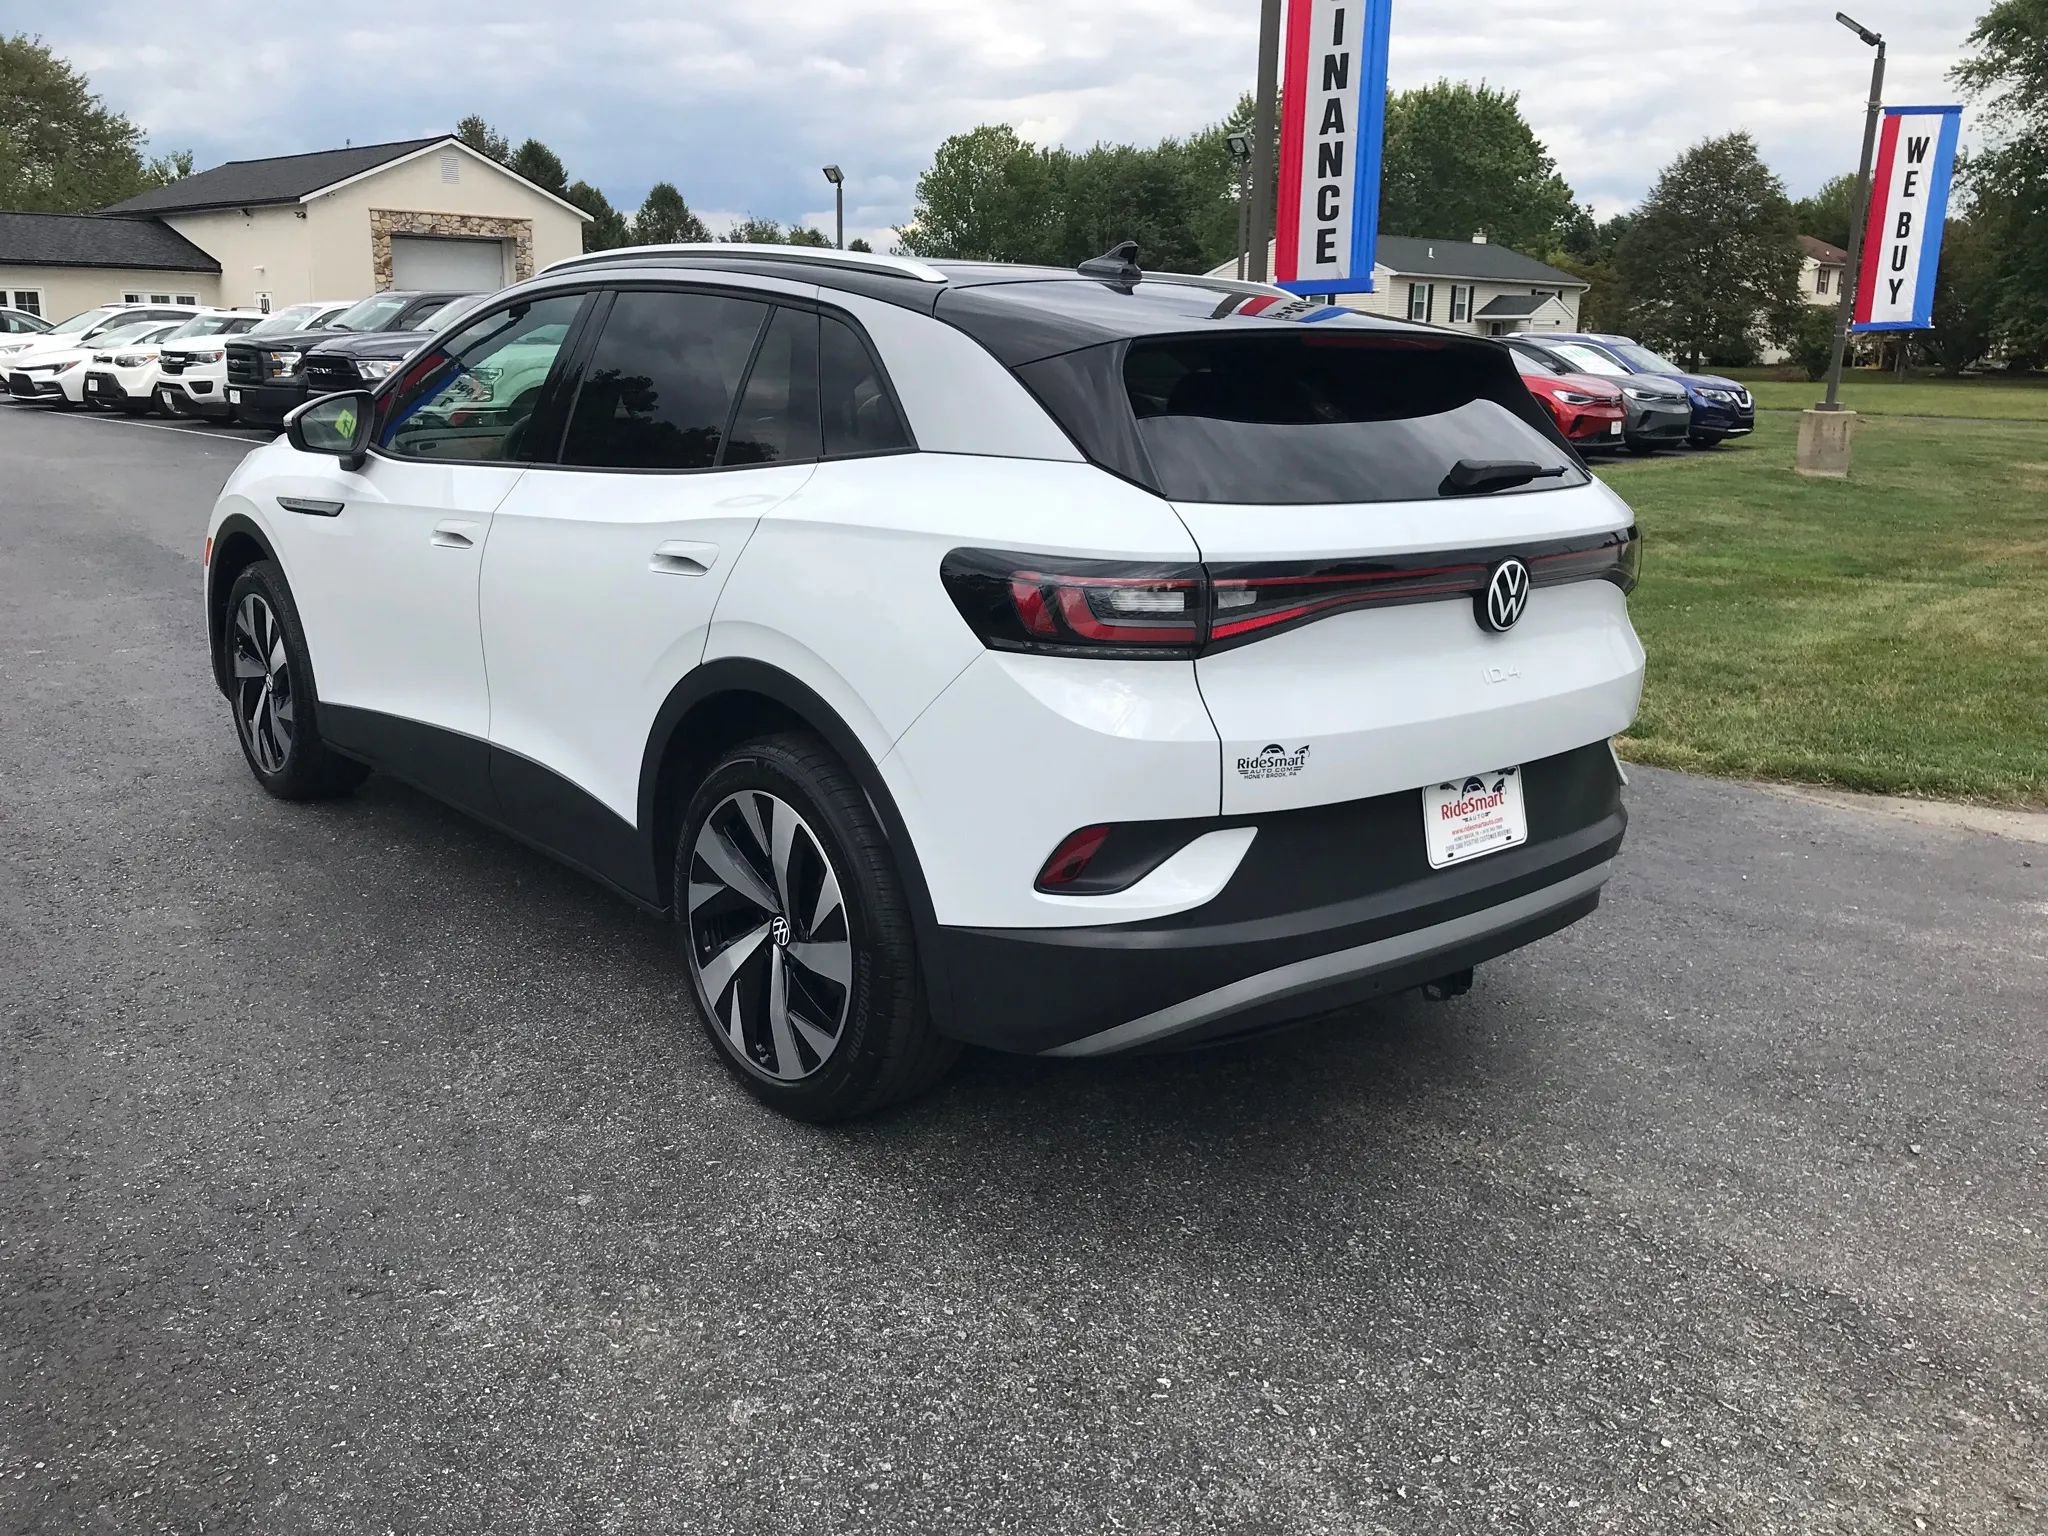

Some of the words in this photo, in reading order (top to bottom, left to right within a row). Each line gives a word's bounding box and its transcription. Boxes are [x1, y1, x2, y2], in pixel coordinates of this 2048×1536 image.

[1316, 0, 1349, 264] INANCE
[1903, 136, 1930, 198] WE
[1889, 211, 1912, 305] BUY
[1237, 755, 1305, 770] RideSmart
[1441, 791, 1504, 820] RideSmart
[1469, 813, 1486, 821] AUTO
[1452, 817, 1504, 835] www.ridesmartauto.com
